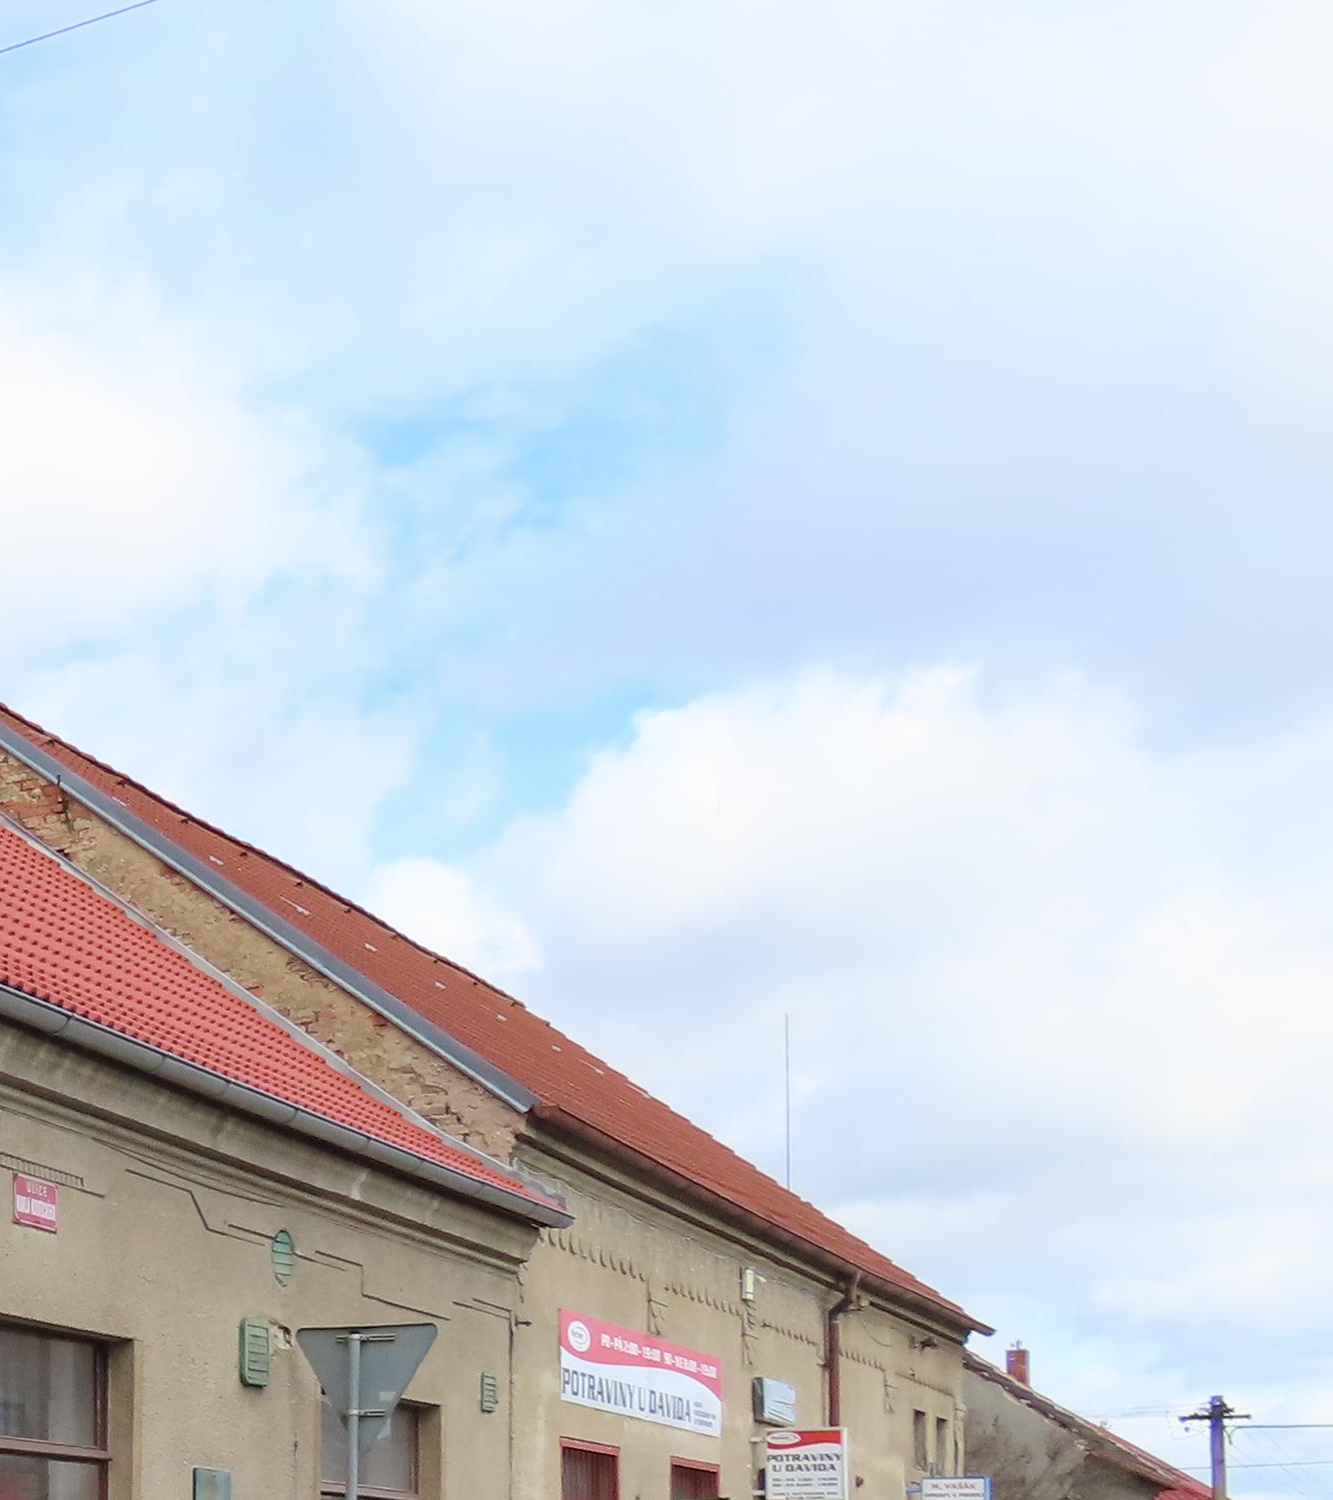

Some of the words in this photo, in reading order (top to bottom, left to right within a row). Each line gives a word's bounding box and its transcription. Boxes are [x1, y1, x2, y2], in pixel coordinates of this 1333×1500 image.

[562, 1367, 635, 1409] POTRAVINY
[637, 1388, 645, 1412] U
[649, 1390, 692, 1423] DAVIDA
[767, 1453, 841, 1462] POTRAVINY
[773, 1464, 781, 1472] U
[785, 1463, 836, 1472] DAVIDA
